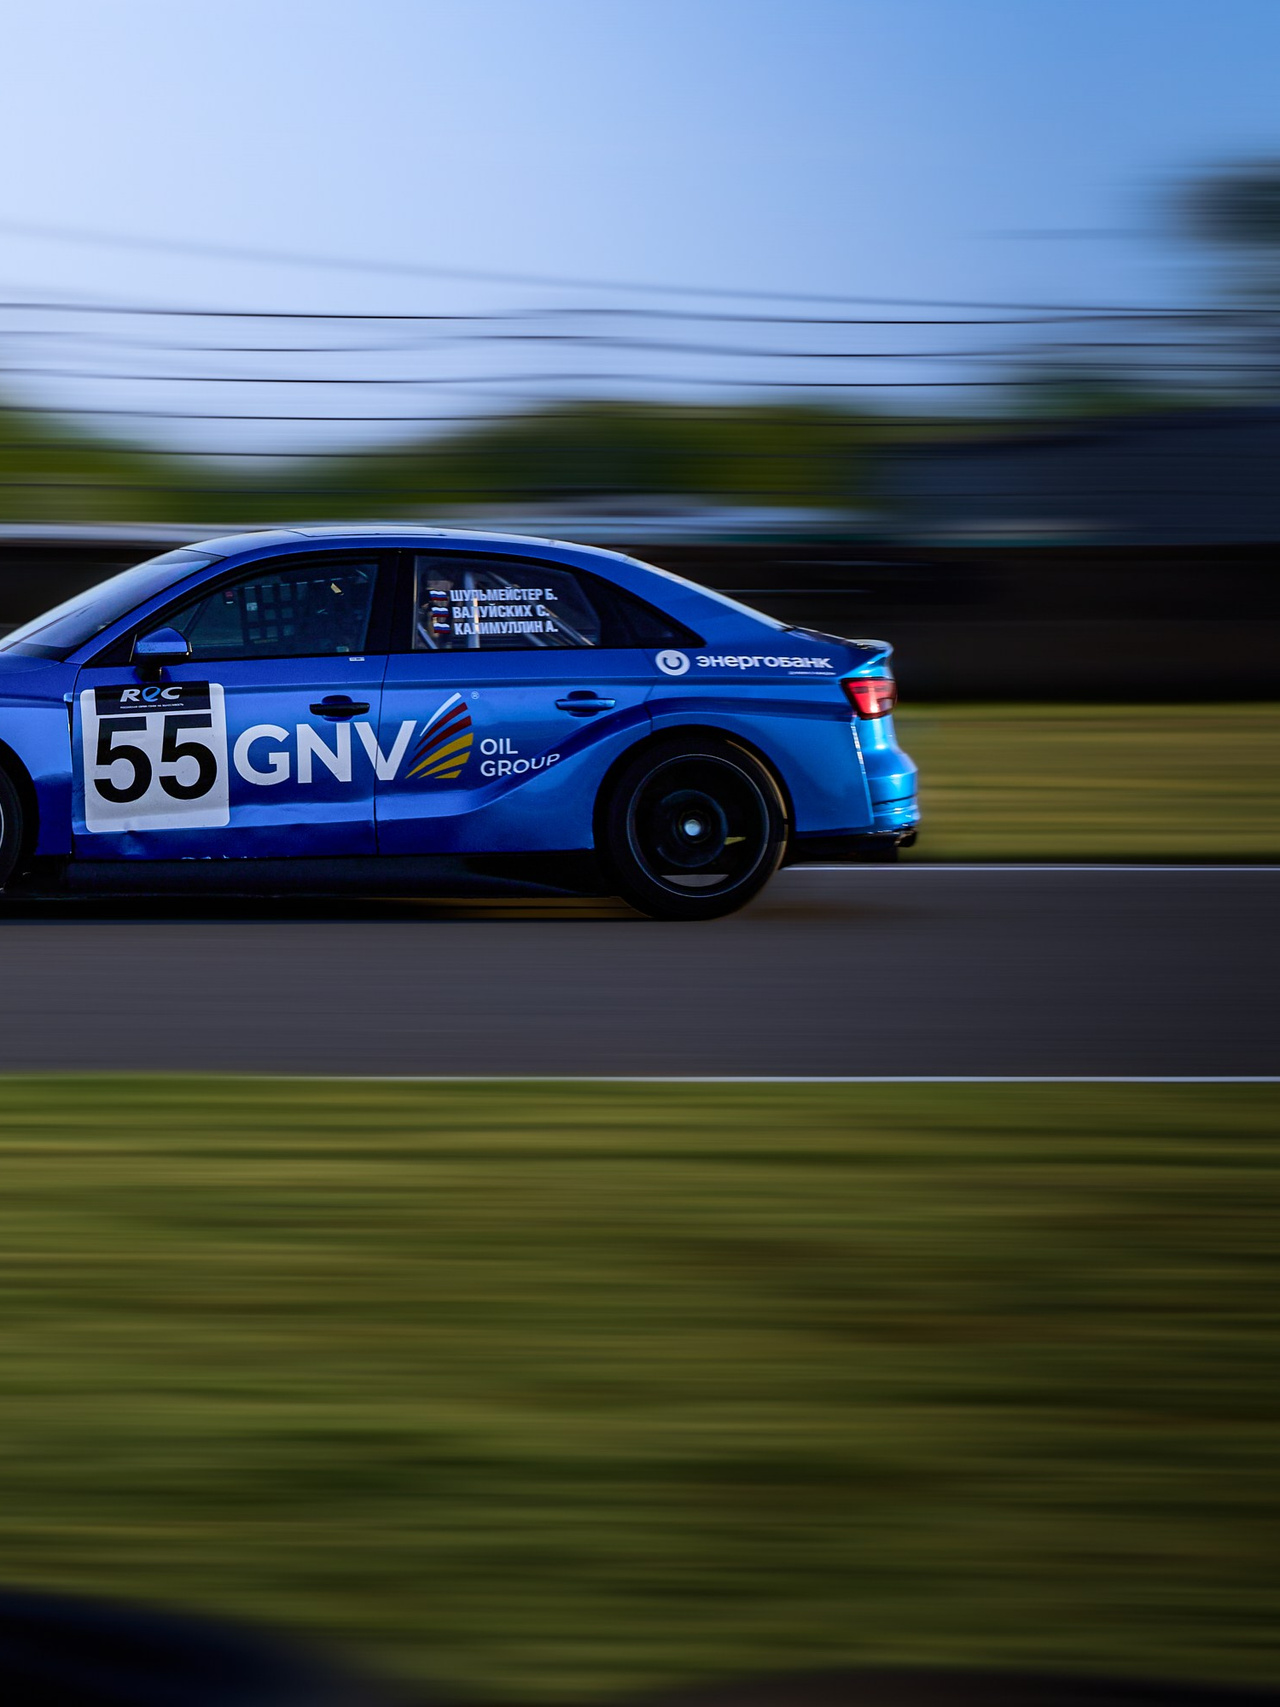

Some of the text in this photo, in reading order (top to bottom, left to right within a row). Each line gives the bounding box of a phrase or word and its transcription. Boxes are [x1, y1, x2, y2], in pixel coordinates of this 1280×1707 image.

[544, 588, 558, 601] Б.
[536, 604, 550, 617] С.
[545, 620, 559, 633] А.
[233, 720, 417, 786] GNV
[480, 738, 518, 755] OIL
[94, 713, 218, 803] 55
[480, 753, 560, 777] GROUP
